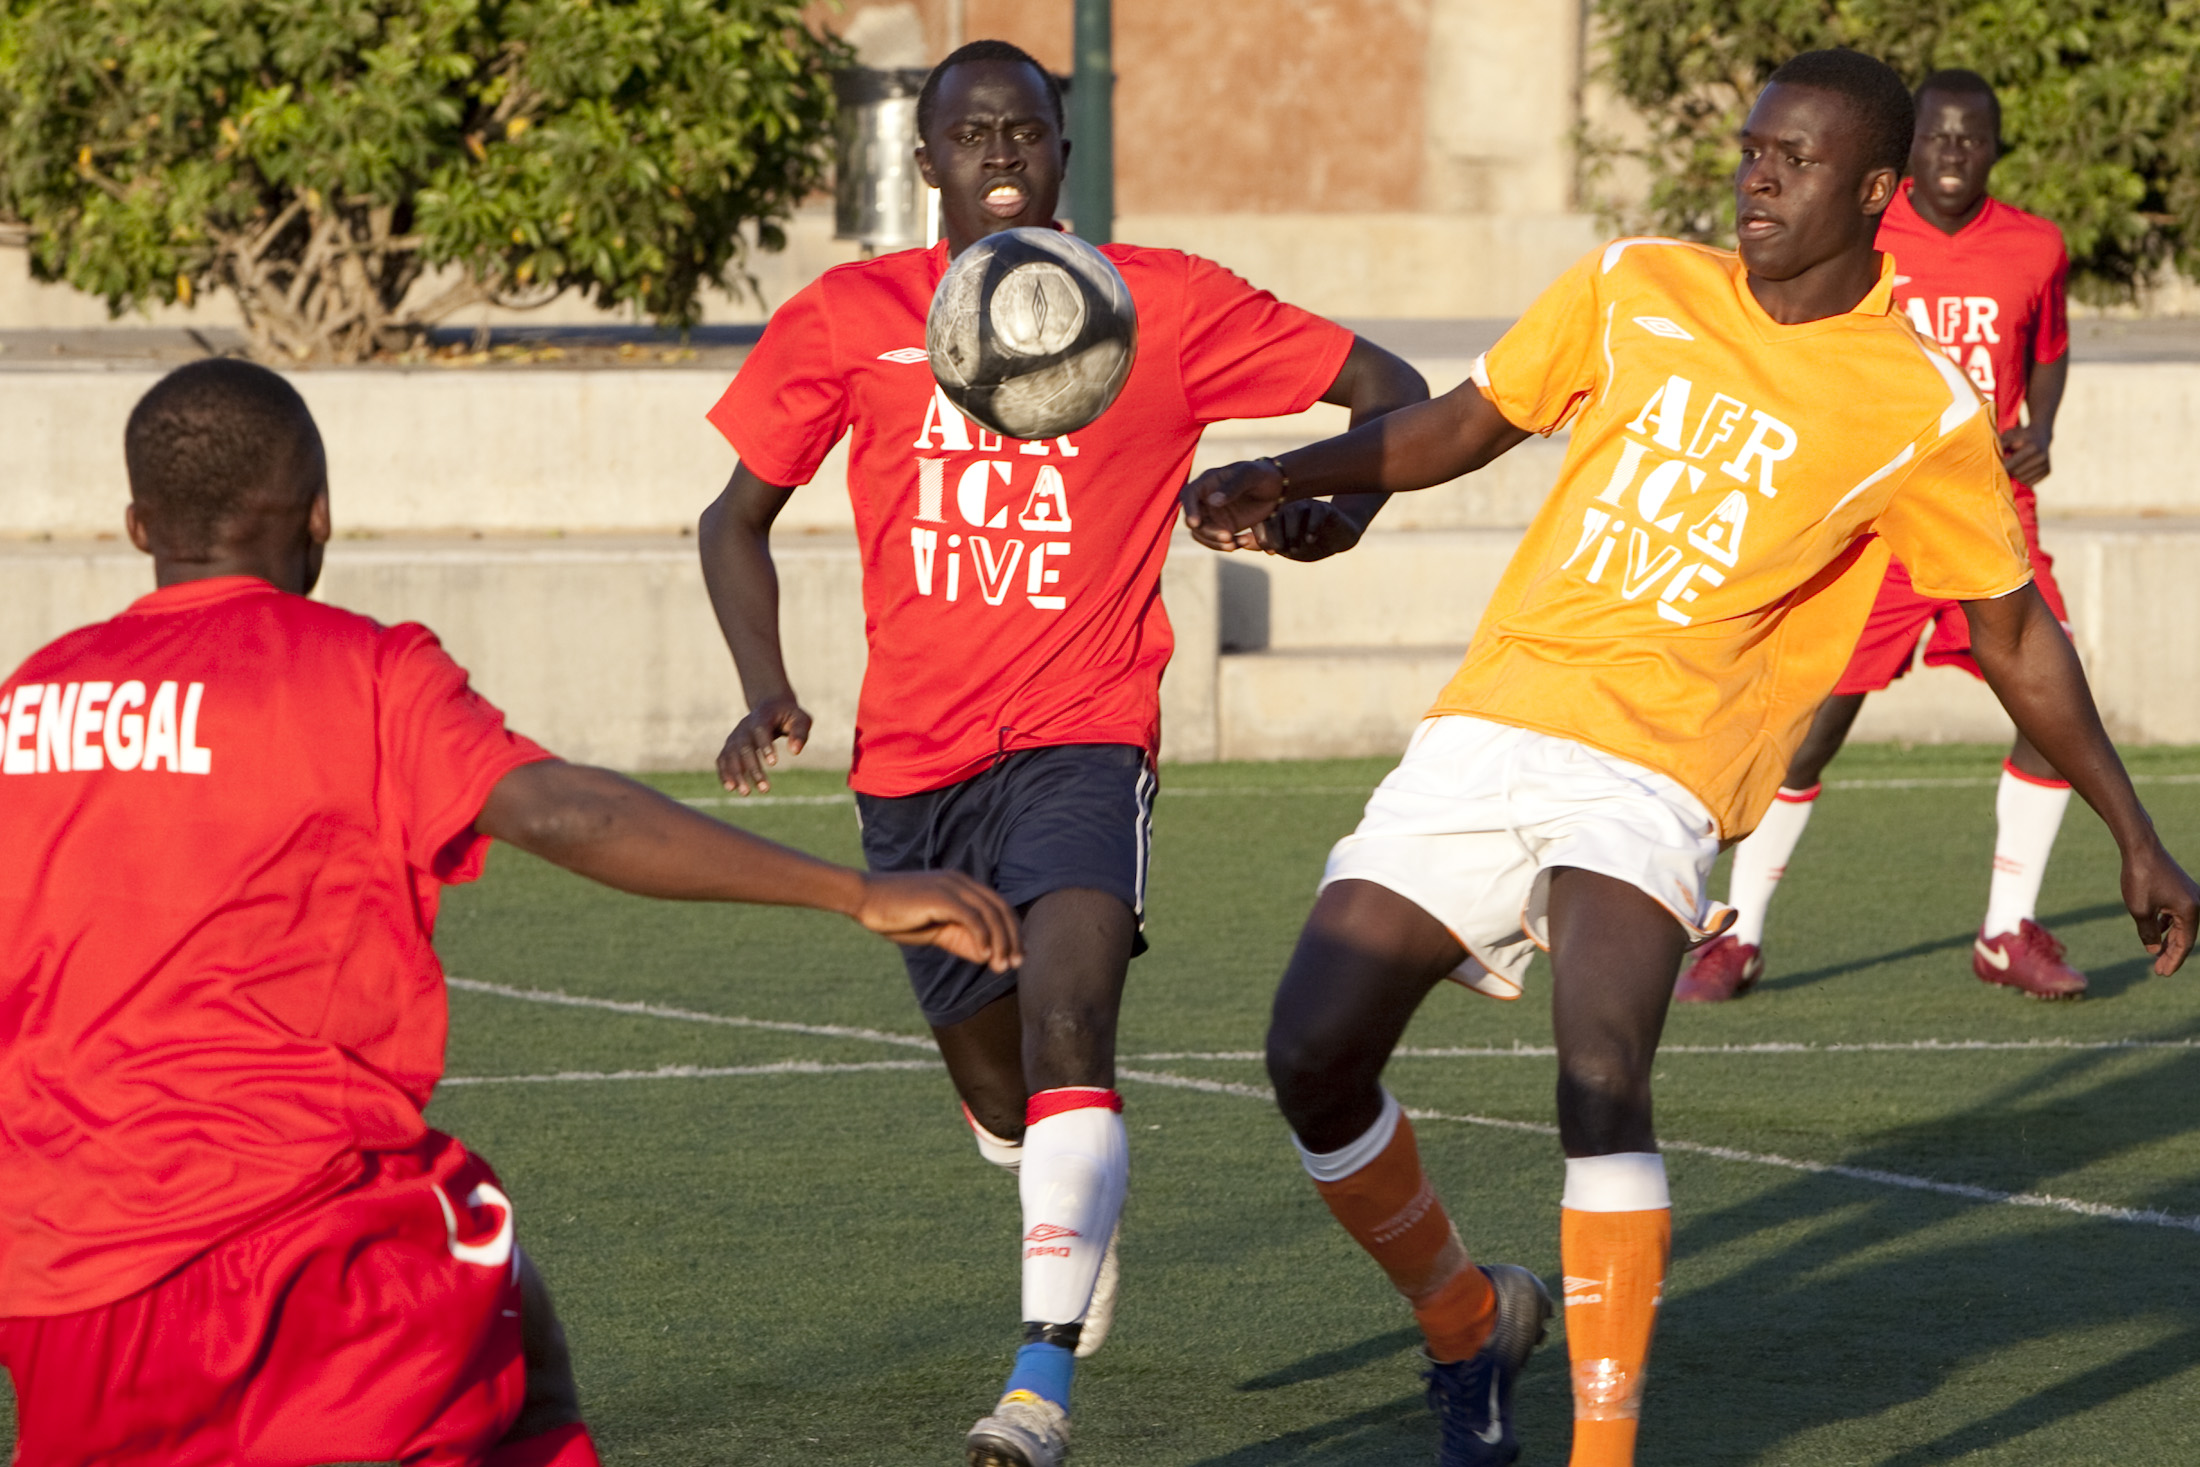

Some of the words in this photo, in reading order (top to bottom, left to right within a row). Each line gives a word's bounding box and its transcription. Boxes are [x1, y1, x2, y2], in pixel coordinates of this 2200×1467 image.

[914, 456, 1073, 533] ICA
[1625, 374, 1798, 499] AFR
[1593, 436, 1749, 568] ICA
